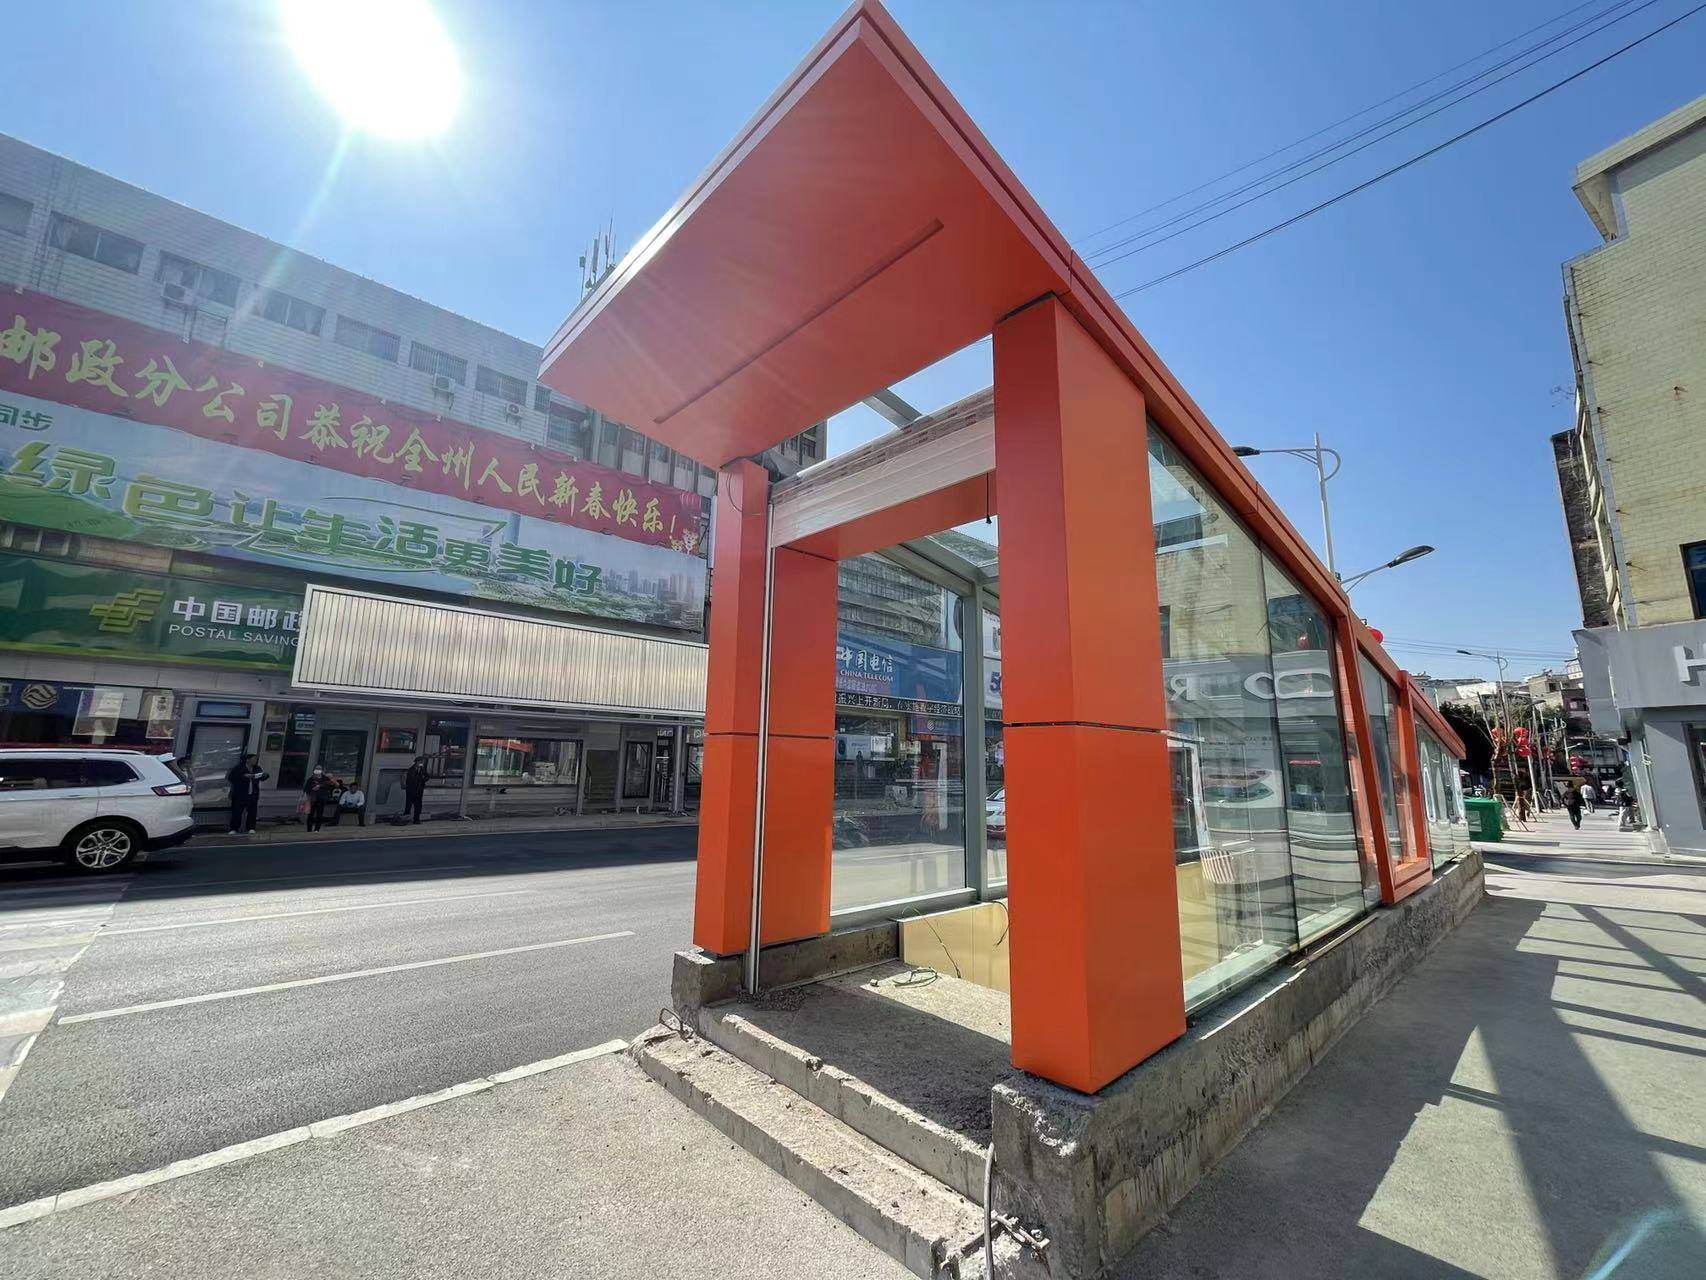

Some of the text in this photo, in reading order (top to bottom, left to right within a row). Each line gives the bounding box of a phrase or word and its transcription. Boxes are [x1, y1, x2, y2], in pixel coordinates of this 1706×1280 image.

[1, 440, 602, 597] 绿色让生活更美好
[168, 624, 237, 641] POSTAL
[840, 646, 894, 674] 中国电信
[839, 669, 863, 679] CHINA
